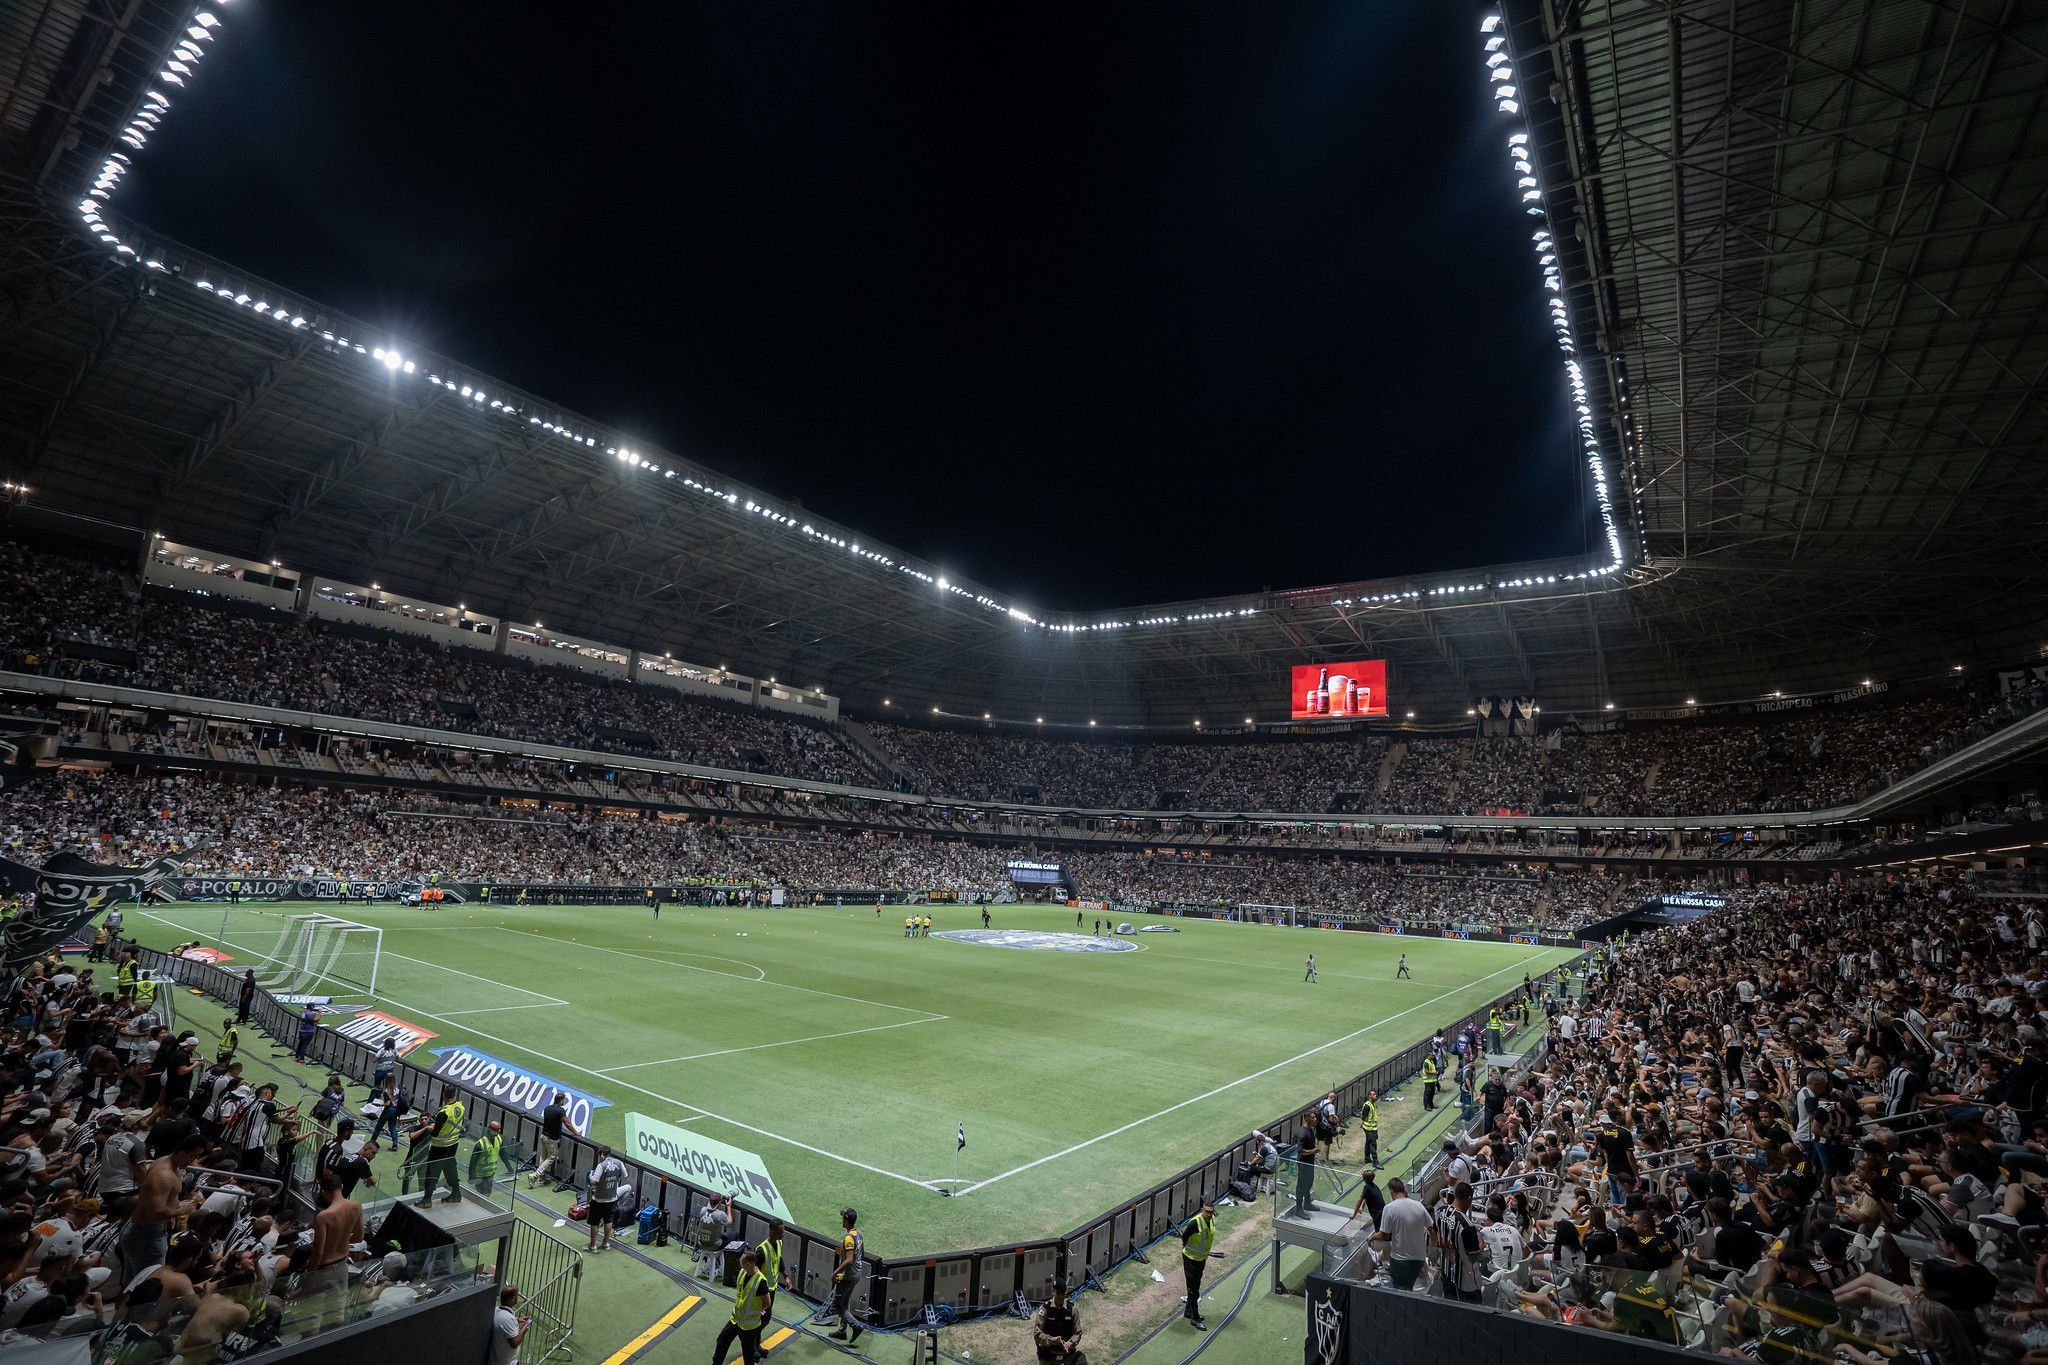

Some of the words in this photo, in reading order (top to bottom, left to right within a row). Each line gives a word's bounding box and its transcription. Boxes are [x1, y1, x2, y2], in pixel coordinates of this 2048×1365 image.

[1078, 901, 1104, 910] BETANO
[1681, 898, 1704, 906] NOSSA
[1320, 922, 1341, 930] BRAX
[1381, 927, 1403, 935] BRAX
[1444, 931, 1467, 940] BRAX
[1512, 936, 1536, 946] BRAX
[1495, 1226, 1512, 1236] bmg
[1502, 1245, 1513, 1270] 7
